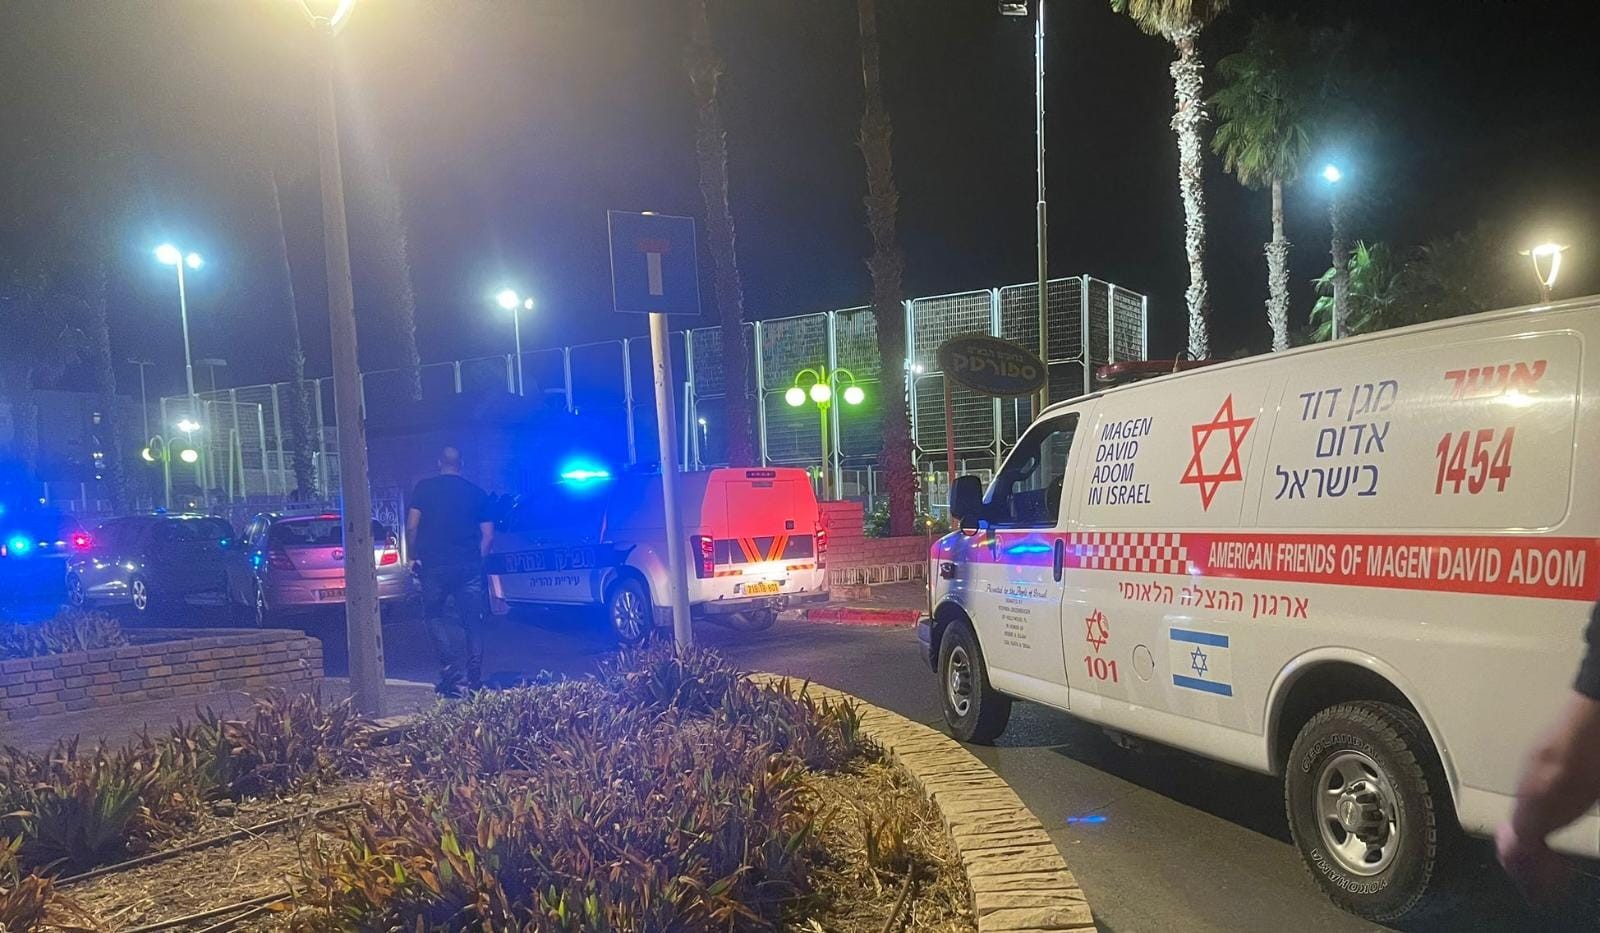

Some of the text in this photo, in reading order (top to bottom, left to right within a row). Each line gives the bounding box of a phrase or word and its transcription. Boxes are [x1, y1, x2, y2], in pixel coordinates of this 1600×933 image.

[1299, 379, 1399, 422] מגן דוד
[1101, 416, 1153, 441] MAGEN
[1315, 421, 1391, 458] אדום
[1096, 440, 1138, 462] DAVID
[1435, 426, 1516, 495] 1454
[1091, 463, 1135, 484] ADOM
[1275, 464, 1379, 500] בישראל
[1088, 484, 1151, 505] IN ISRAEL
[1208, 542, 1587, 588] AMERICAN FRIENDS OF MAGEN DAVID ADOM
[1119, 580, 1309, 619] ארגון ההצלה הלאומי
[1084, 655, 1118, 683] 101
[1310, 847, 1389, 894] YOKOHAMA
